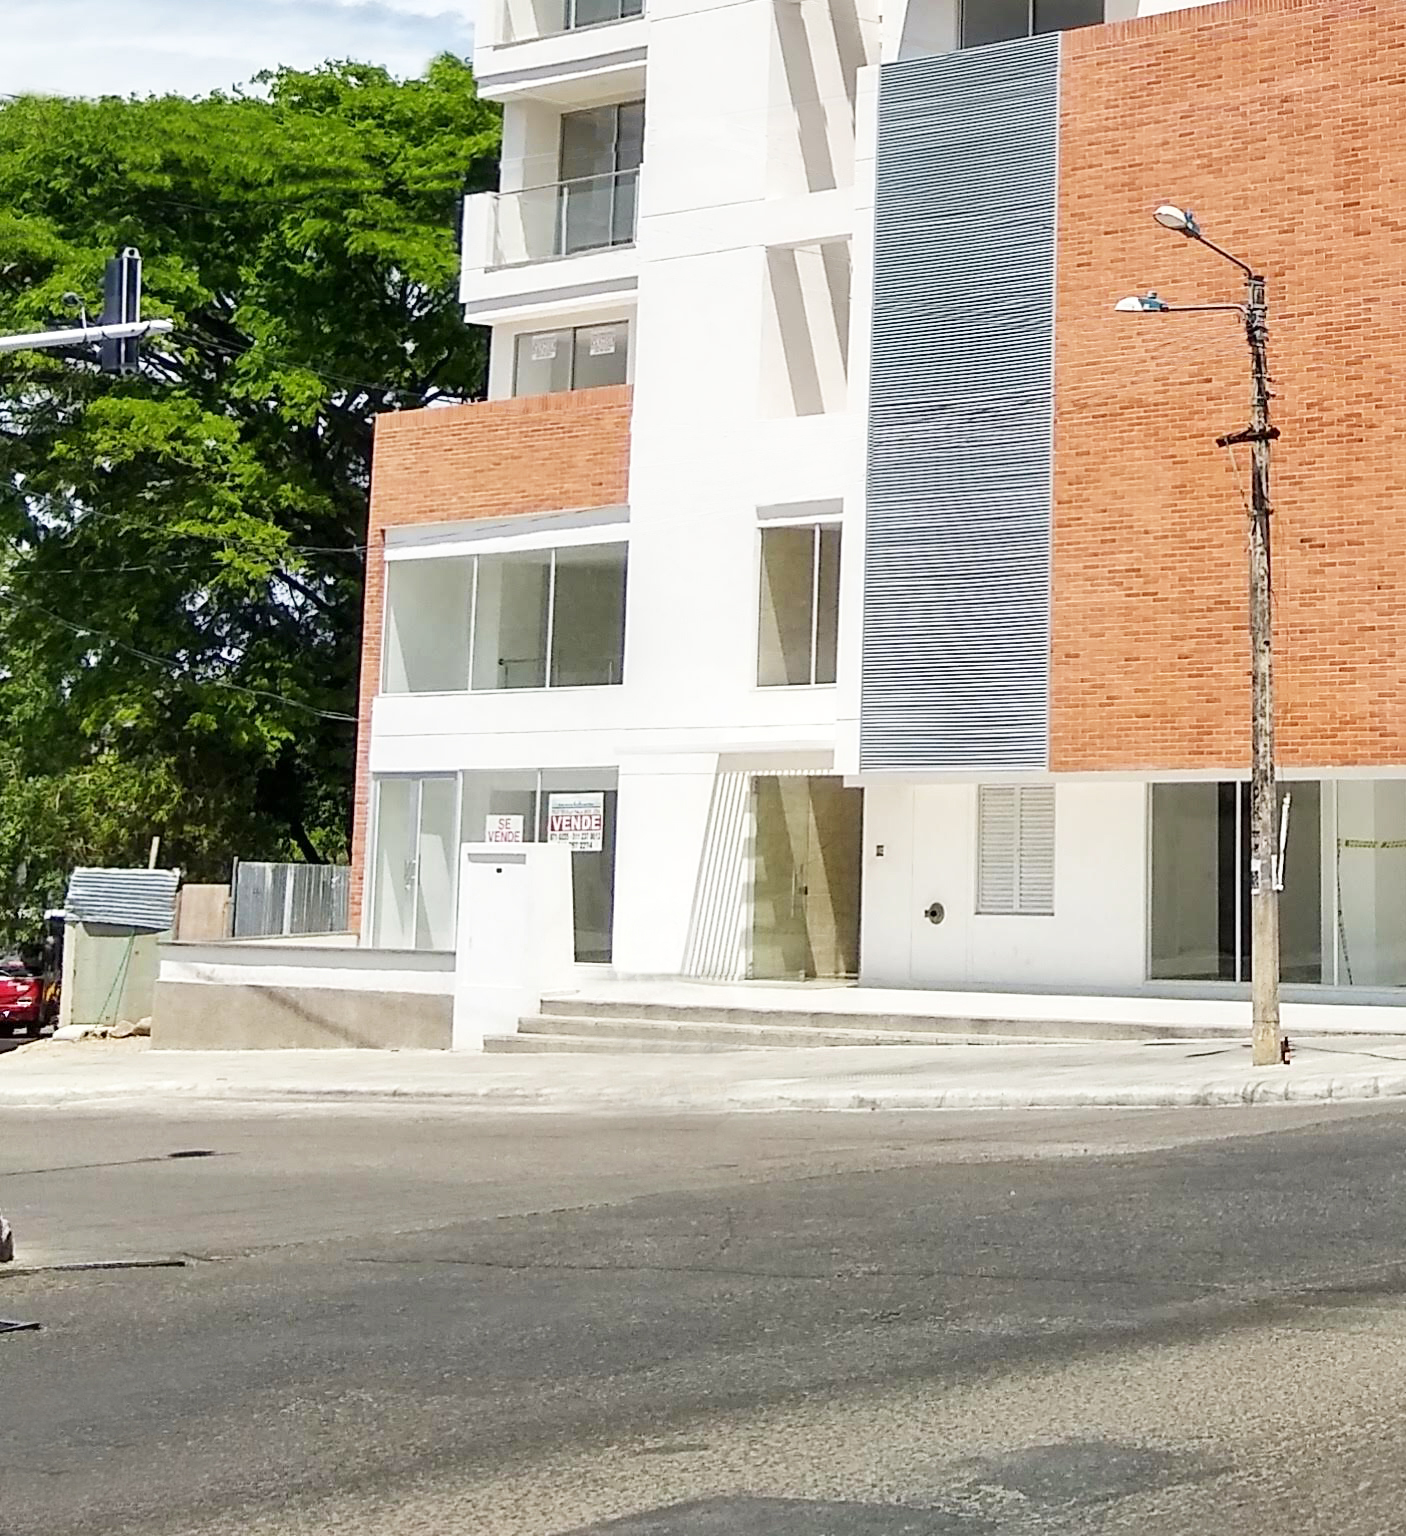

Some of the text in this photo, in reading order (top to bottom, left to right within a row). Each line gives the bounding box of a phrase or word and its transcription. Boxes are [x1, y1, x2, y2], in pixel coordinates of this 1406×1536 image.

[498, 818, 511, 830] SE
[551, 815, 601, 831] VENDE
[488, 830, 520, 843] VENDE
